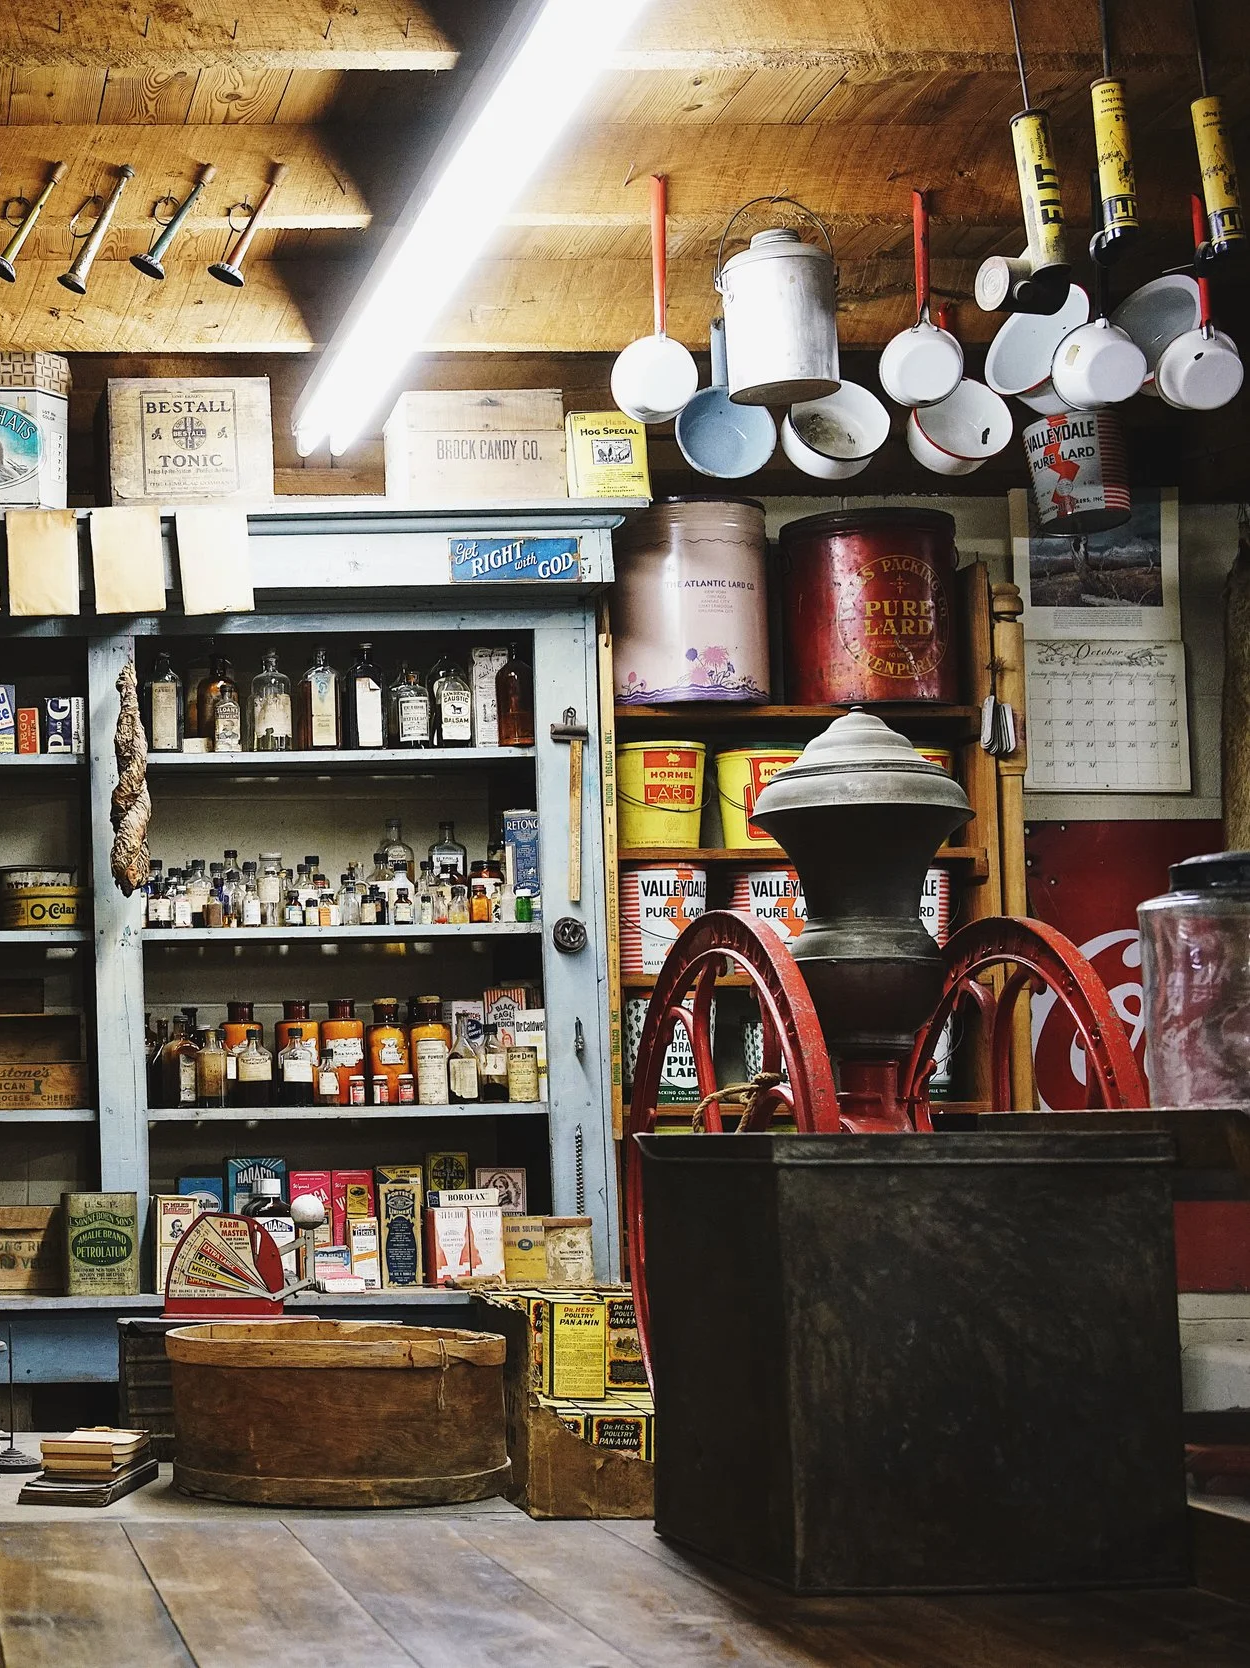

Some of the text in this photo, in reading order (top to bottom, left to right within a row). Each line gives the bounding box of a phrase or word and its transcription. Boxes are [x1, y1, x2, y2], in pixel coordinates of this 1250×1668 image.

[1036, 127, 1046, 161] Mosquitoes
[145, 400, 231, 414] BESTALL
[580, 427, 639, 436] HOG SPECIAL
[1027, 420, 1096, 454] VALLEYDALE
[437, 440, 543, 461] BROCK CANDY CO.
[158, 454, 223, 468] TONIC
[1033, 446, 1095, 472] PURE LARD
[455, 539, 574, 579] Get RIGHT with GOD
[881, 558, 939, 591] PACKING
[684, 580, 726, 588] ATLANTIC
[728, 580, 746, 589] LARD
[864, 600, 932, 618] PURE
[863, 618, 934, 636] LARD
[849, 639, 933, 676] DAVENPORT
[1077, 642, 1124, 660] October
[444, 696, 469, 704] CAUSTIC
[47, 698, 70, 720] G
[19, 713, 29, 751] ARGO
[48, 733, 71, 754] P
[605, 729, 614, 807] LONDON TOBACCO MKT.
[650, 770, 694, 780] HORMEL
[646, 787, 694, 801] LARD
[641, 880, 706, 898] VALLEYDALE
[646, 907, 704, 918] PURE LARD
[756, 907, 787, 918] PURE
[495, 1003, 516, 1012] BLACK
[521, 1052, 533, 1060] Dee
[612, 1029, 621, 1086] LONDON TOBACCO
[41, 1094, 77, 1102] CHEESE
[388, 1190, 413, 1200] PORTER'S
[389, 1207, 412, 1215] LINIMENT
[74, 1211, 134, 1226] SONNEBORN SONS
[219, 1221, 239, 1229] FARM
[506, 1225, 520, 1233] FLOUR
[78, 1230, 127, 1244] AMALIE BRAND
[76, 1247, 127, 1258] PETROLATUM
[203, 1244, 235, 1270] EXTRA LARGE
[196, 1254, 221, 1271] LARGE
[191, 1265, 217, 1279] MEDIUM
[559, 1318, 600, 1327] PAN-A-MIN
[604, 1430, 634, 1438] POULTRY
[615, 1423, 635, 1431] HESS
[599, 1437, 639, 1446] PAN-A-MIN
